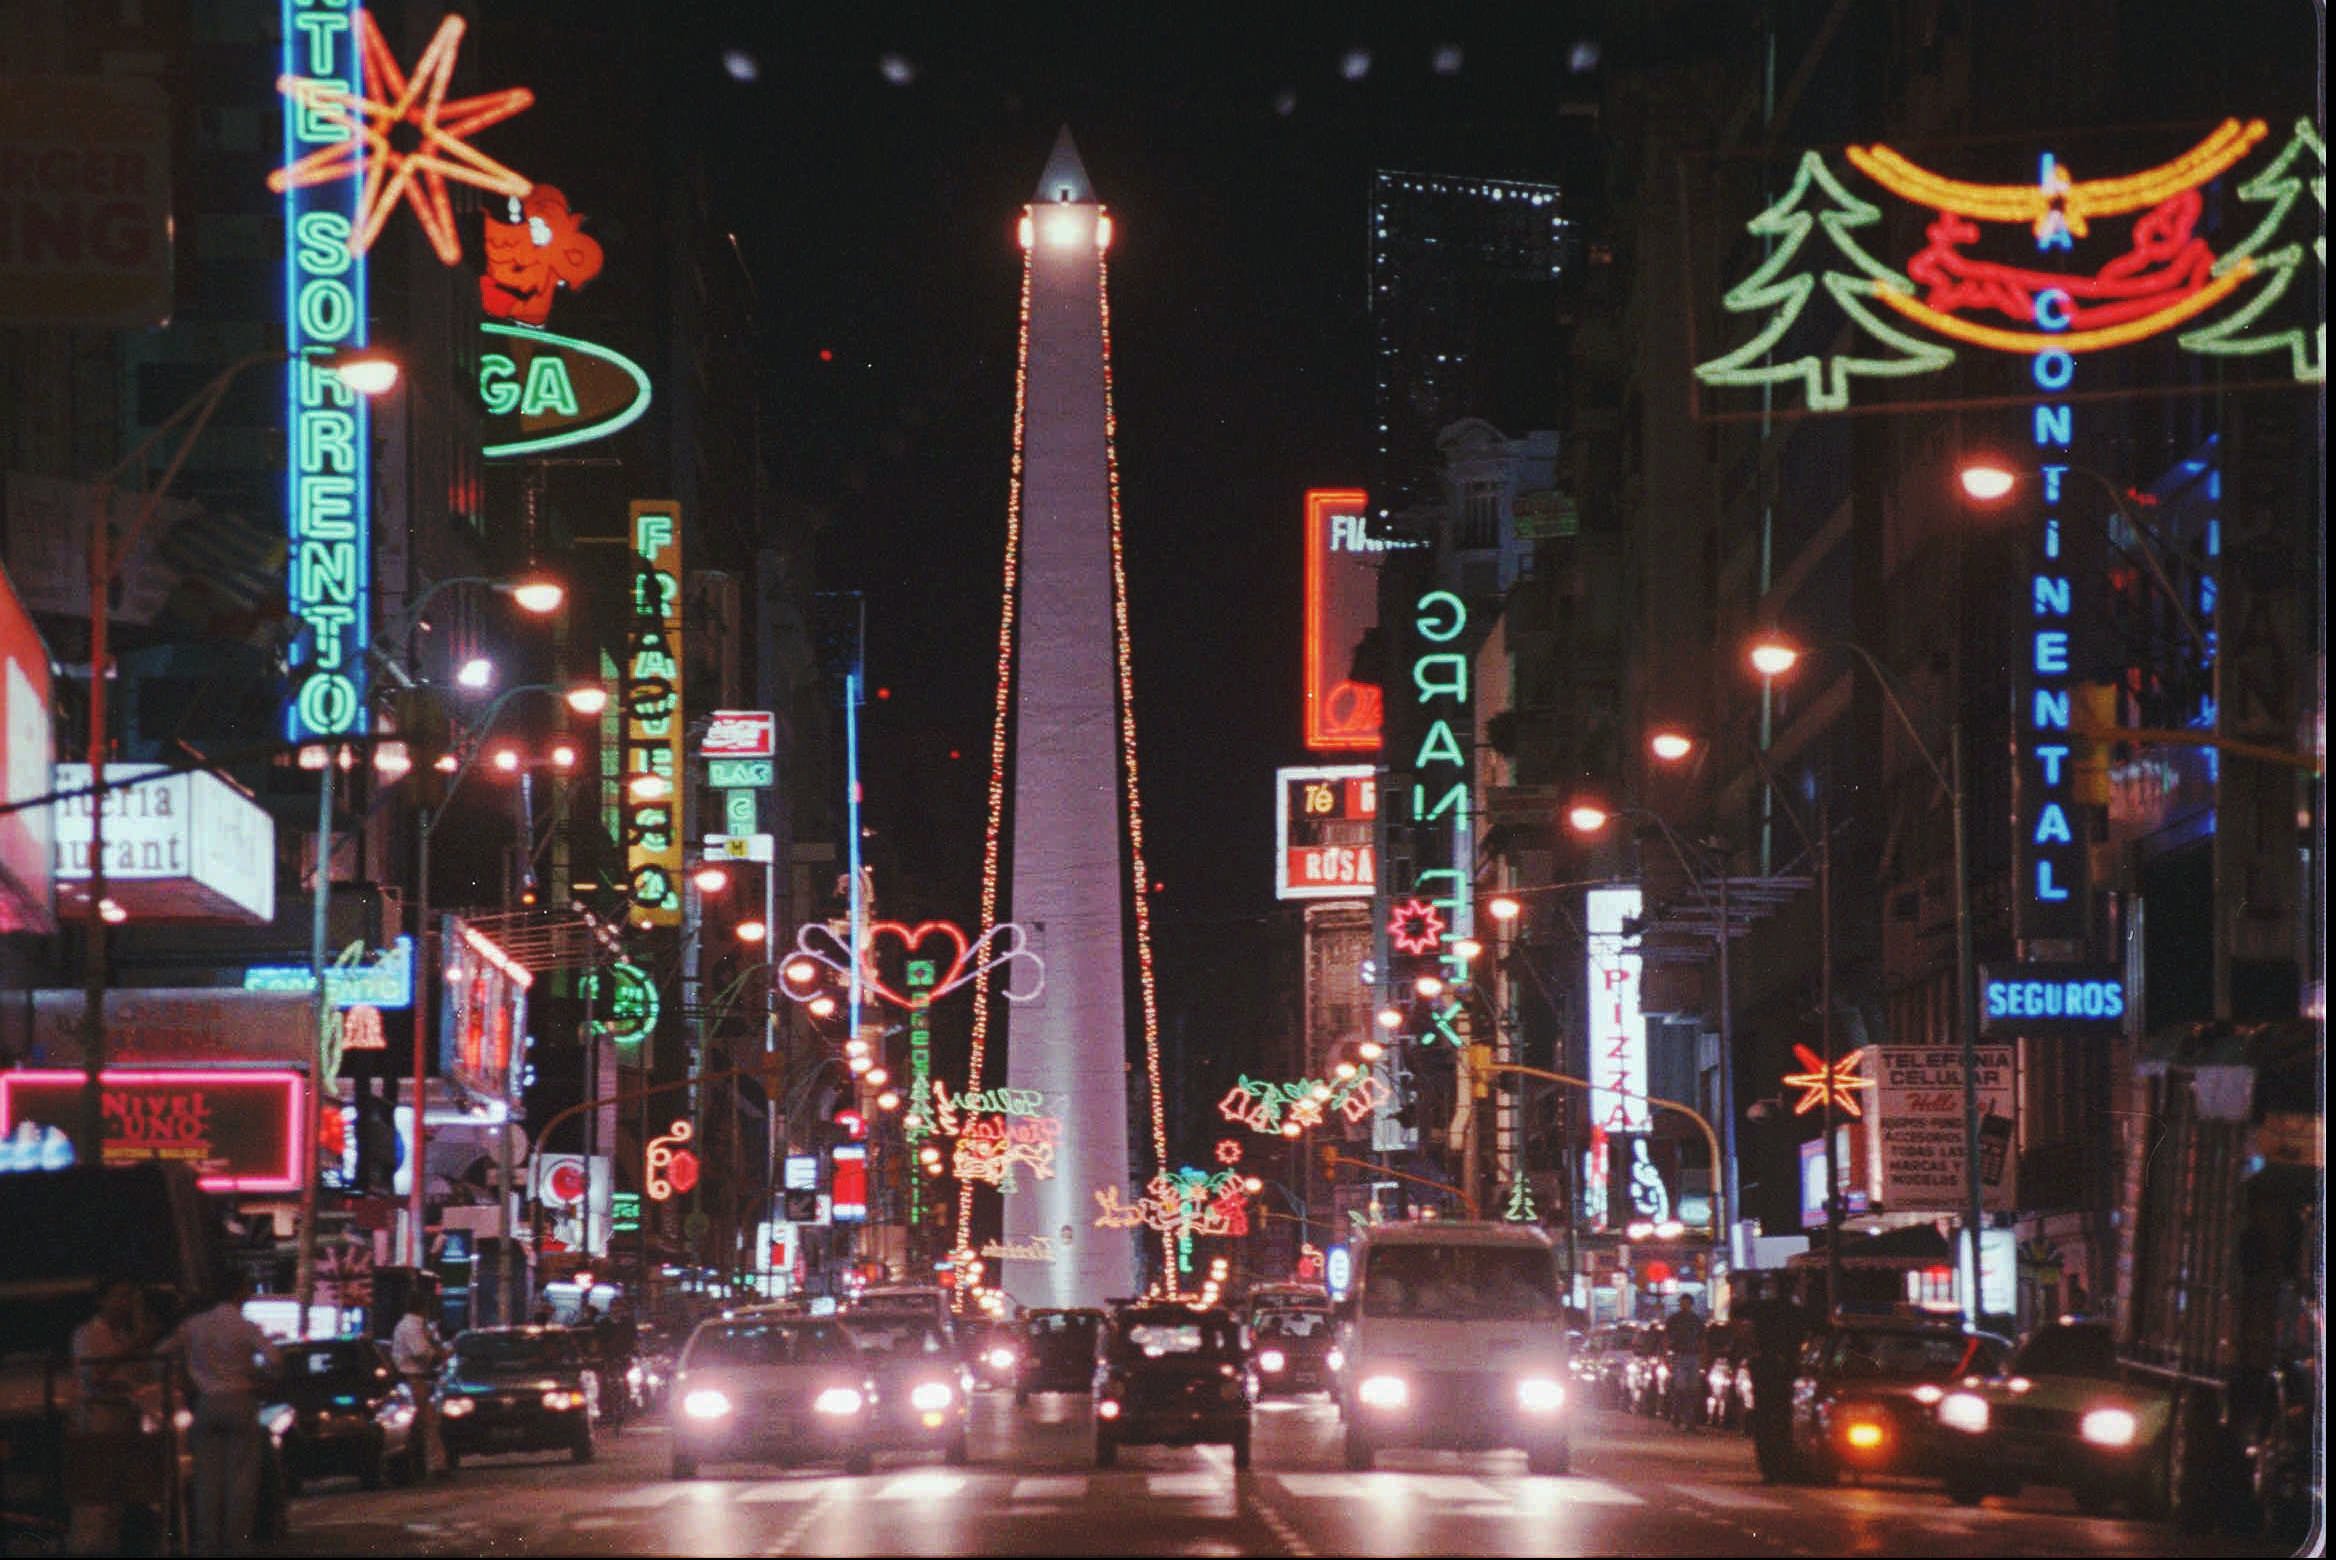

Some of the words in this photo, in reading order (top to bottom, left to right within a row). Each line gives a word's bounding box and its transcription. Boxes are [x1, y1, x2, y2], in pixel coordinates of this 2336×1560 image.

[295, 0, 351, 145] TE
[480, 354, 579, 417] GA
[297, 211, 357, 737] SORRENTO
[1304, 849, 1375, 883] ROSA
[1988, 981, 2123, 1017] SEGUROS
[1603, 968, 1634, 1126] PIZZA
[101, 1091, 212, 1118] NIVEL
[123, 1116, 204, 1141] UNO
[1889, 1160, 1947, 1172] MARCAS
